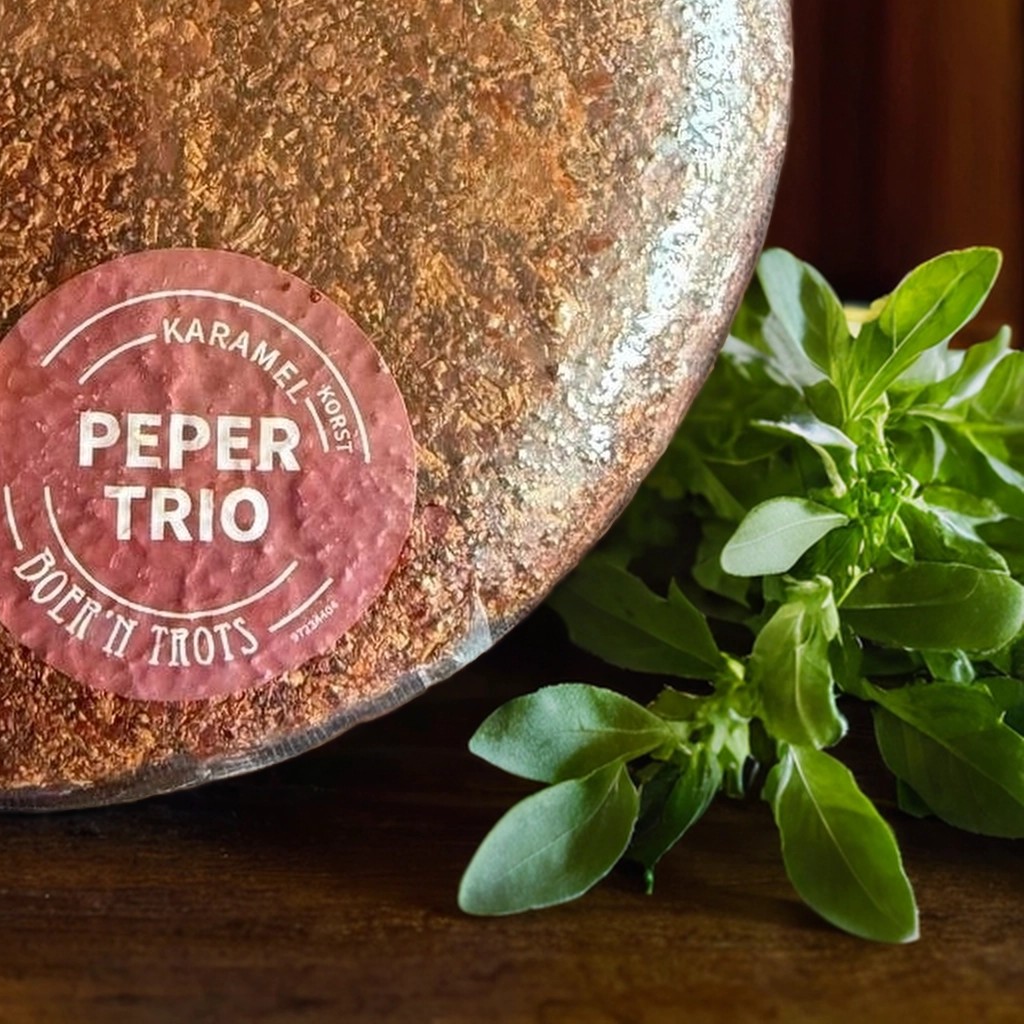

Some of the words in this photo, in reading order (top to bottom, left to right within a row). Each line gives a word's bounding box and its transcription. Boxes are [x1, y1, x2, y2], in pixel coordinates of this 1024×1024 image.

[162, 317, 309, 405] KARAMEL
[78, 410, 302, 472] PEPER
[316, 384, 354, 454] KORST
[103, 485, 270, 543] TRIO
[147, 616, 259, 668] TROTS
